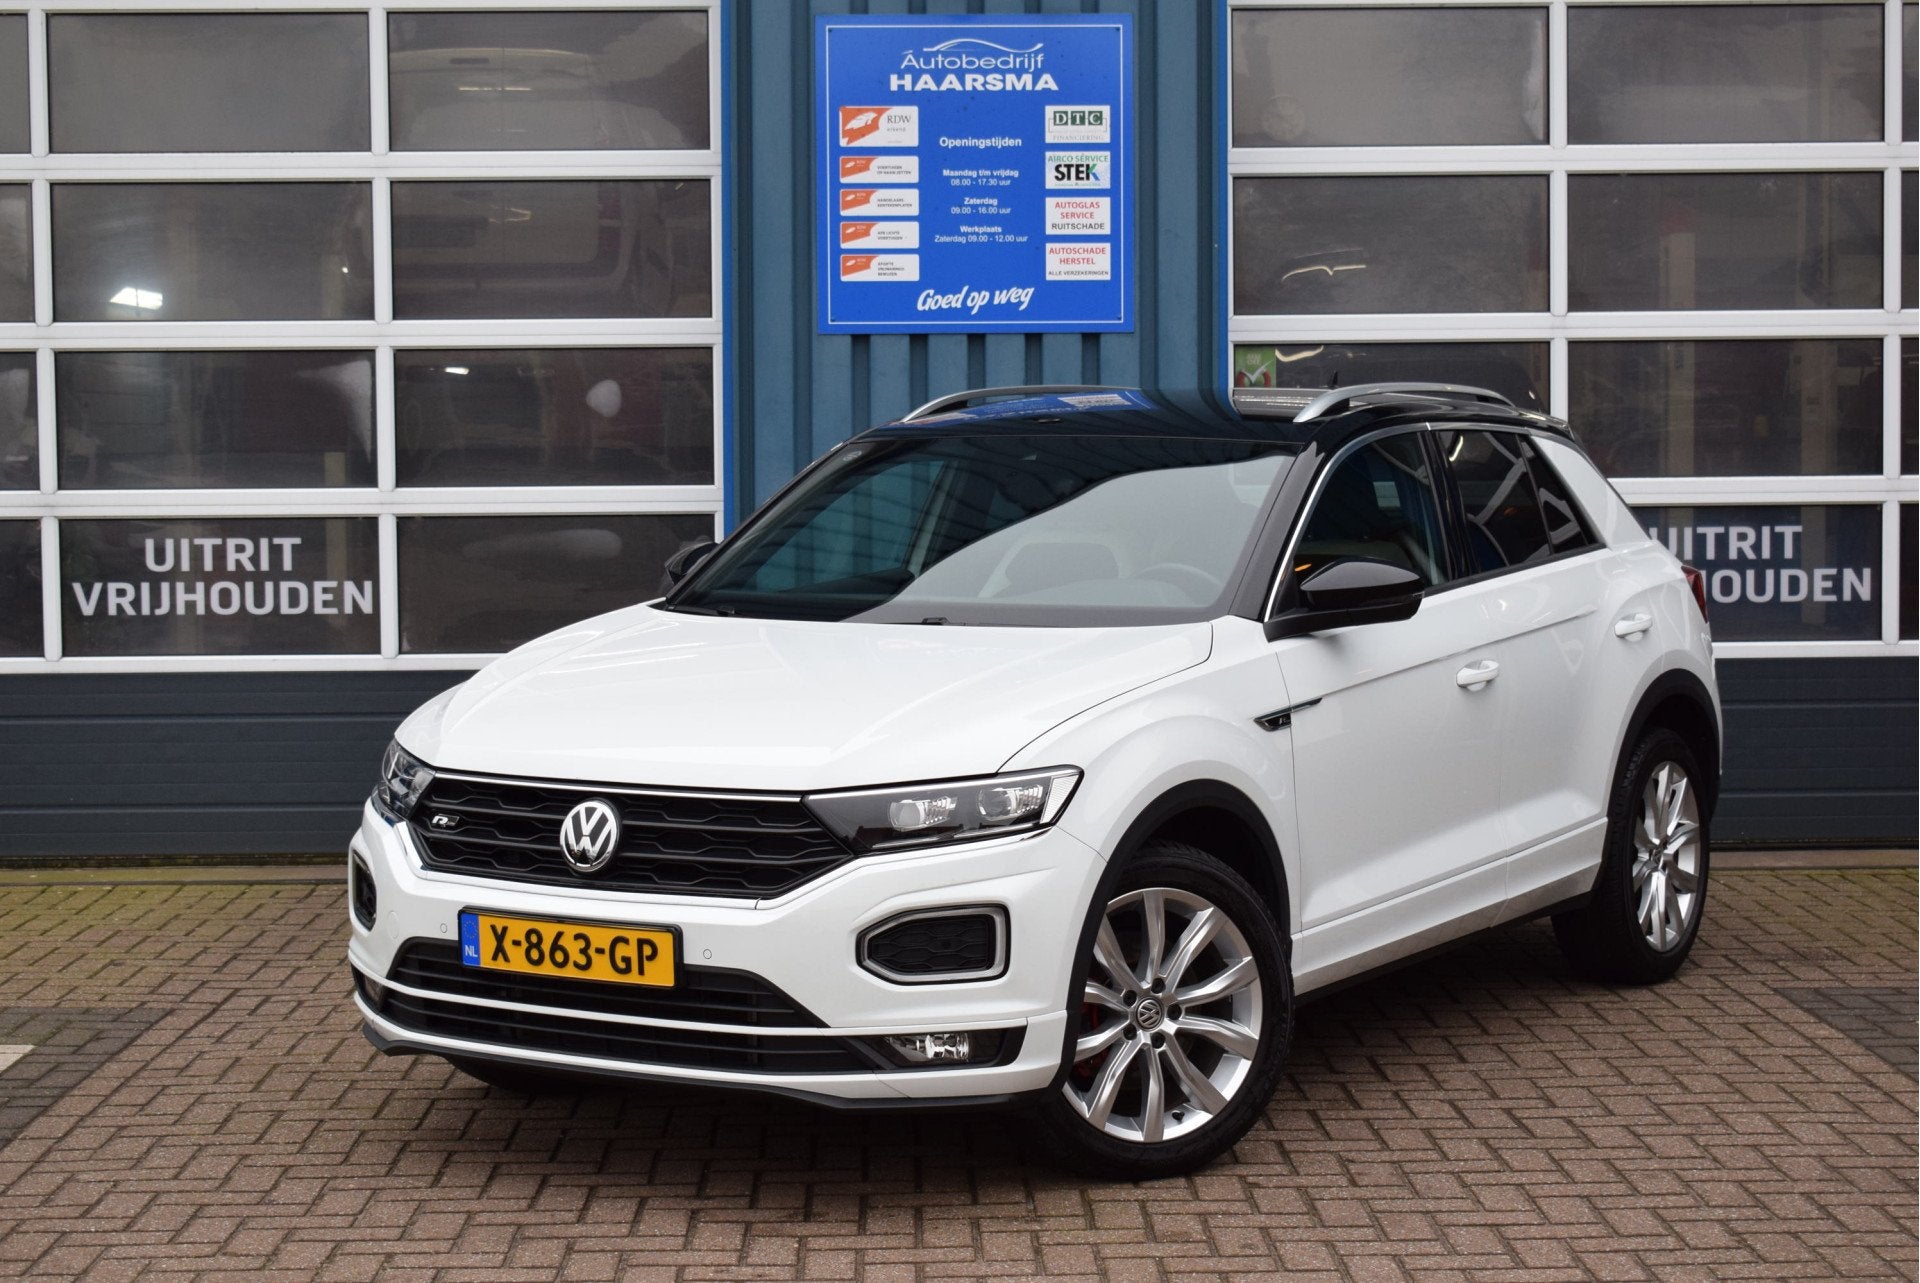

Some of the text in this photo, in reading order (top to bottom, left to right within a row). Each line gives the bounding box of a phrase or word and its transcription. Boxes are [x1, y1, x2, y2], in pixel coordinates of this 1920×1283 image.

[900, 53, 1045, 72] Autobedrijf
[889, 73, 1060, 92] HAARSMA
[886, 114, 911, 125] RDW
[1054, 111, 1102, 126] DTC
[939, 136, 1022, 149] Openingstijden
[1048, 155, 1109, 163] AIRCO SERVICE
[942, 169, 977, 178] Maandag
[992, 169, 1019, 178] vrijdag
[1054, 163, 1101, 182] STEK
[950, 178, 971, 186] 08.00
[978, 178, 998, 186] 17.30
[963, 197, 998, 206] Zaterdag
[1054, 201, 1101, 209] AUTOGLAS
[950, 206, 971, 214] 09.00
[978, 206, 998, 214] 16.00
[1060, 211, 1095, 220] SERVICE
[960, 225, 1002, 234] Werkplaats
[1051, 222, 1105, 230] RUITSCHADE
[934, 235, 966, 244] Zaterdag
[967, 235, 988, 243] 09.00
[995, 235, 1014, 243] 12.00
[1049, 247, 1107, 255] AUTOSCHADE
[1059, 257, 1096, 265] HERSTEL
[917, 285, 1035, 315] Goed op weg
[144, 536, 302, 573] UITRIT
[71, 579, 374, 616] VRIJHOUDEN
[464, 923, 660, 976] NL X-863-GP
